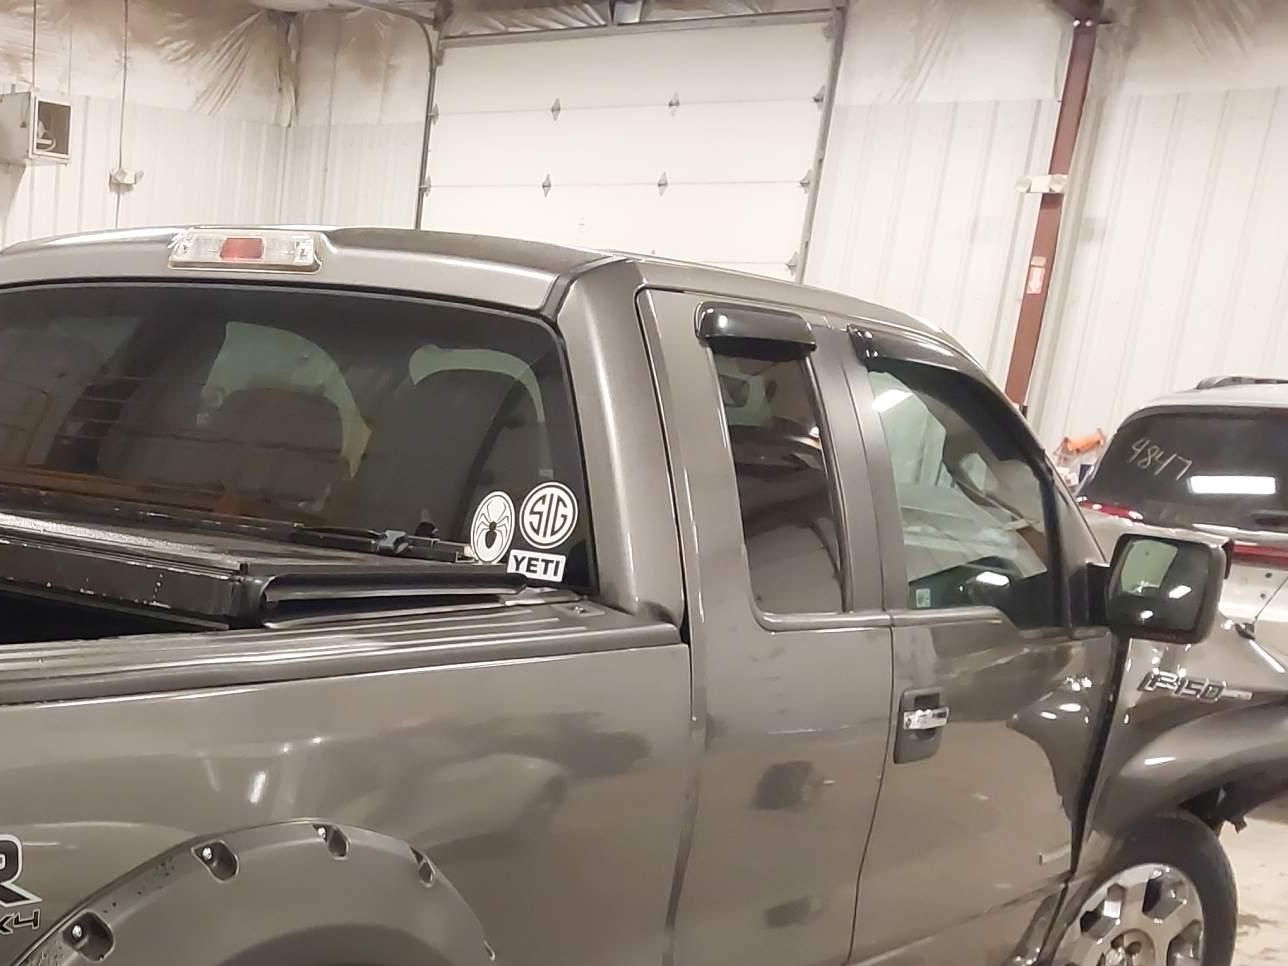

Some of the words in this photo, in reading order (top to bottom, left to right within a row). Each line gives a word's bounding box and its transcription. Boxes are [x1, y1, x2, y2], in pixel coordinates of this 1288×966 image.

[1129, 437, 1193, 481] 4847
[528, 493, 568, 538] SIG
[512, 555, 560, 577] YETI
